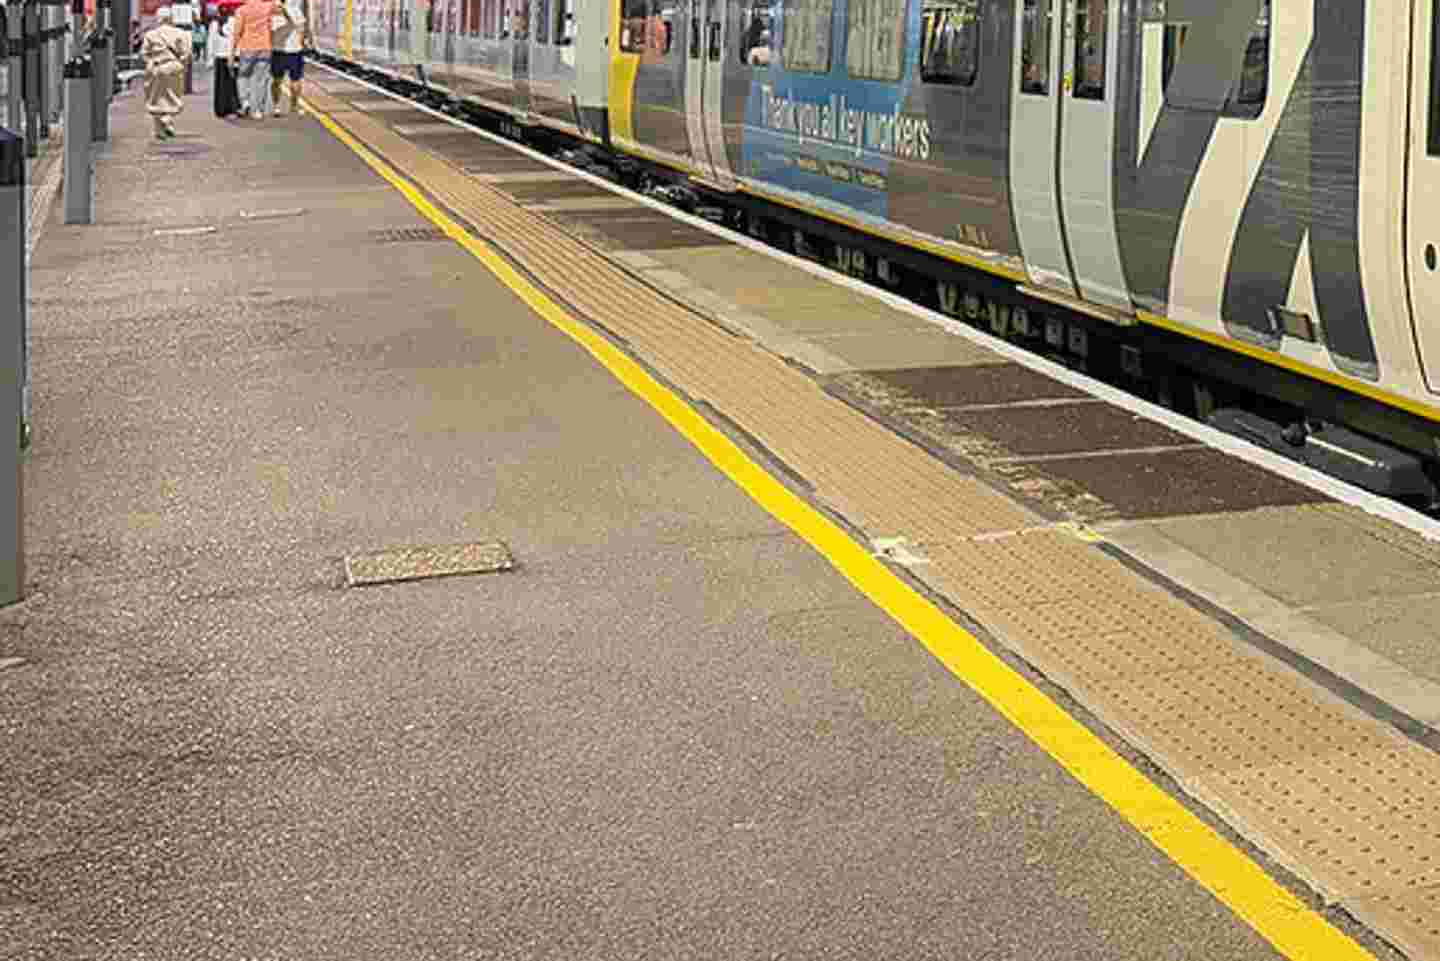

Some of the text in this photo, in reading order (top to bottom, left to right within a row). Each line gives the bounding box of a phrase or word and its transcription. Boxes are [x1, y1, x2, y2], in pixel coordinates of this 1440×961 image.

[760, 82, 797, 131] Thank
[798, 100, 819, 144] you
[839, 92, 865, 159] key
[866, 100, 931, 161] workers
